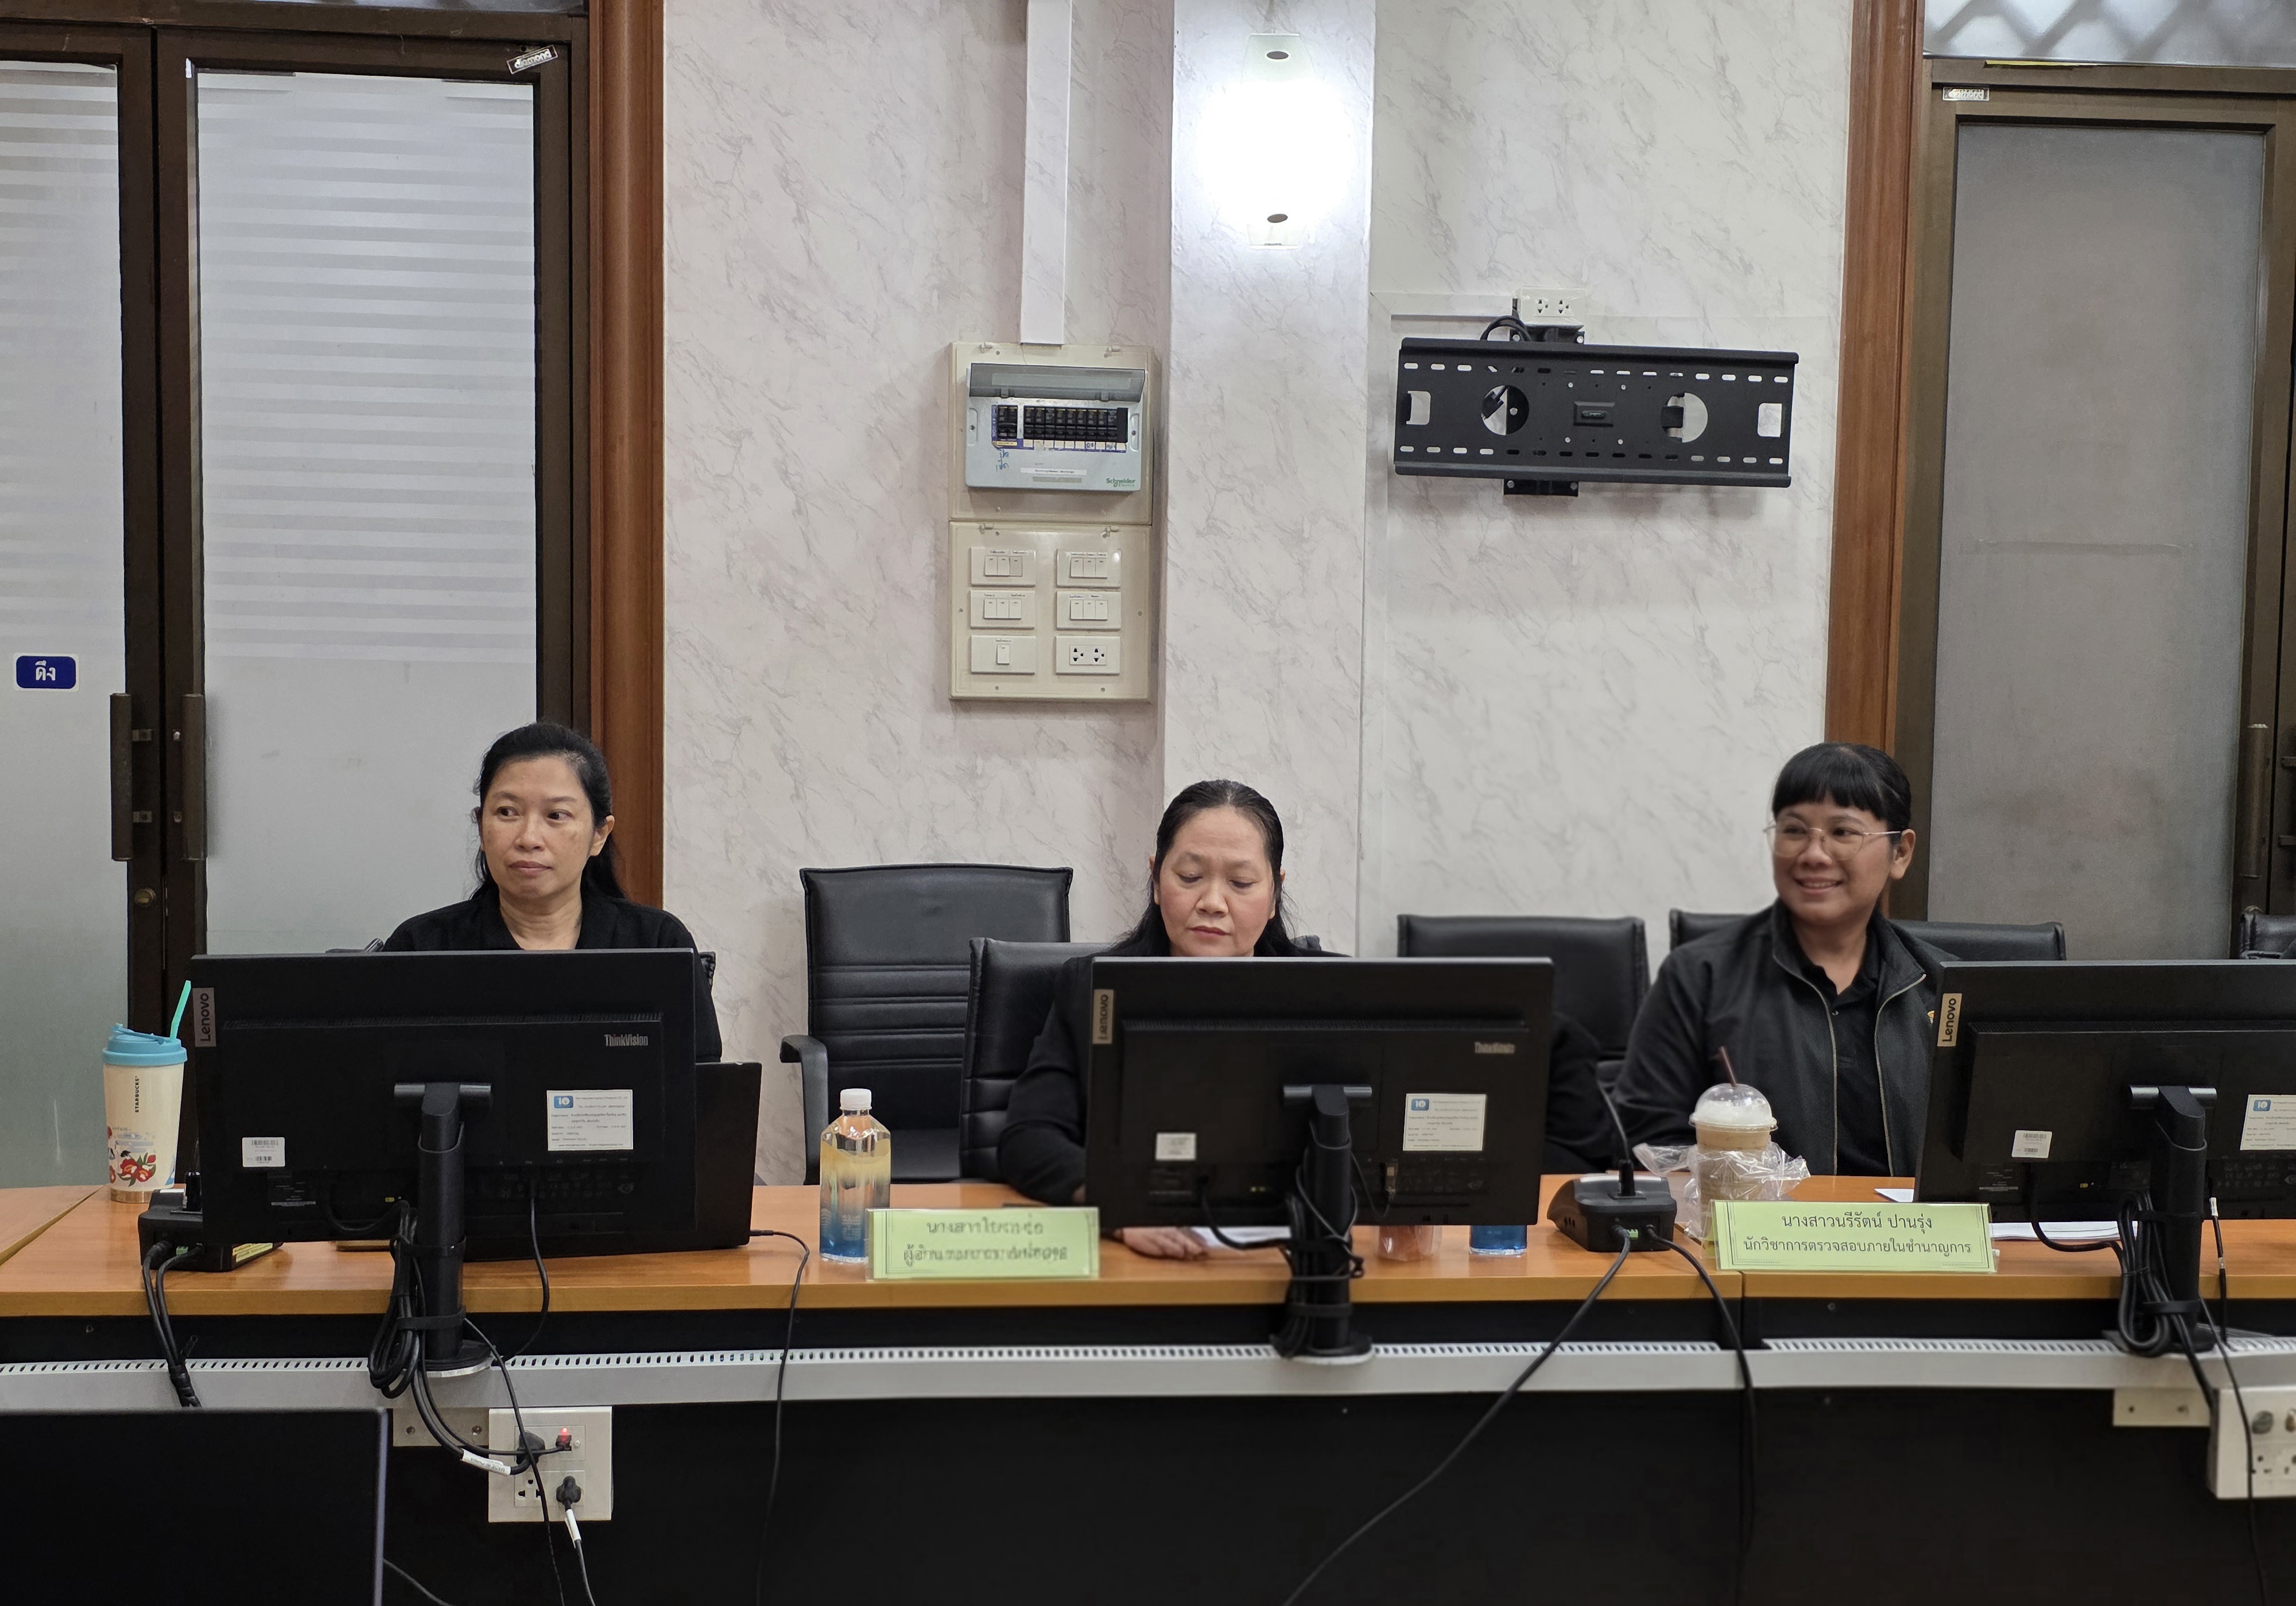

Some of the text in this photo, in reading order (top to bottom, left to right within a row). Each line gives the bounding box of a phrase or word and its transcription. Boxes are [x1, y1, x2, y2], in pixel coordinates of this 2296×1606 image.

[35, 660, 56, 681] ดึง
[200, 992, 211, 1042] Lenovo
[1097, 994, 1109, 1039] Lenovo
[1942, 998, 1957, 1042] Lenovo
[604, 1033, 649, 1046] ThinkVision
[1782, 1211, 1933, 1234] นางสาวนรีรัตน์ ปานรุ่ง
[1743, 1236, 1971, 1257] นักวิชาการตรวจสอบภายในชำนาญการ
